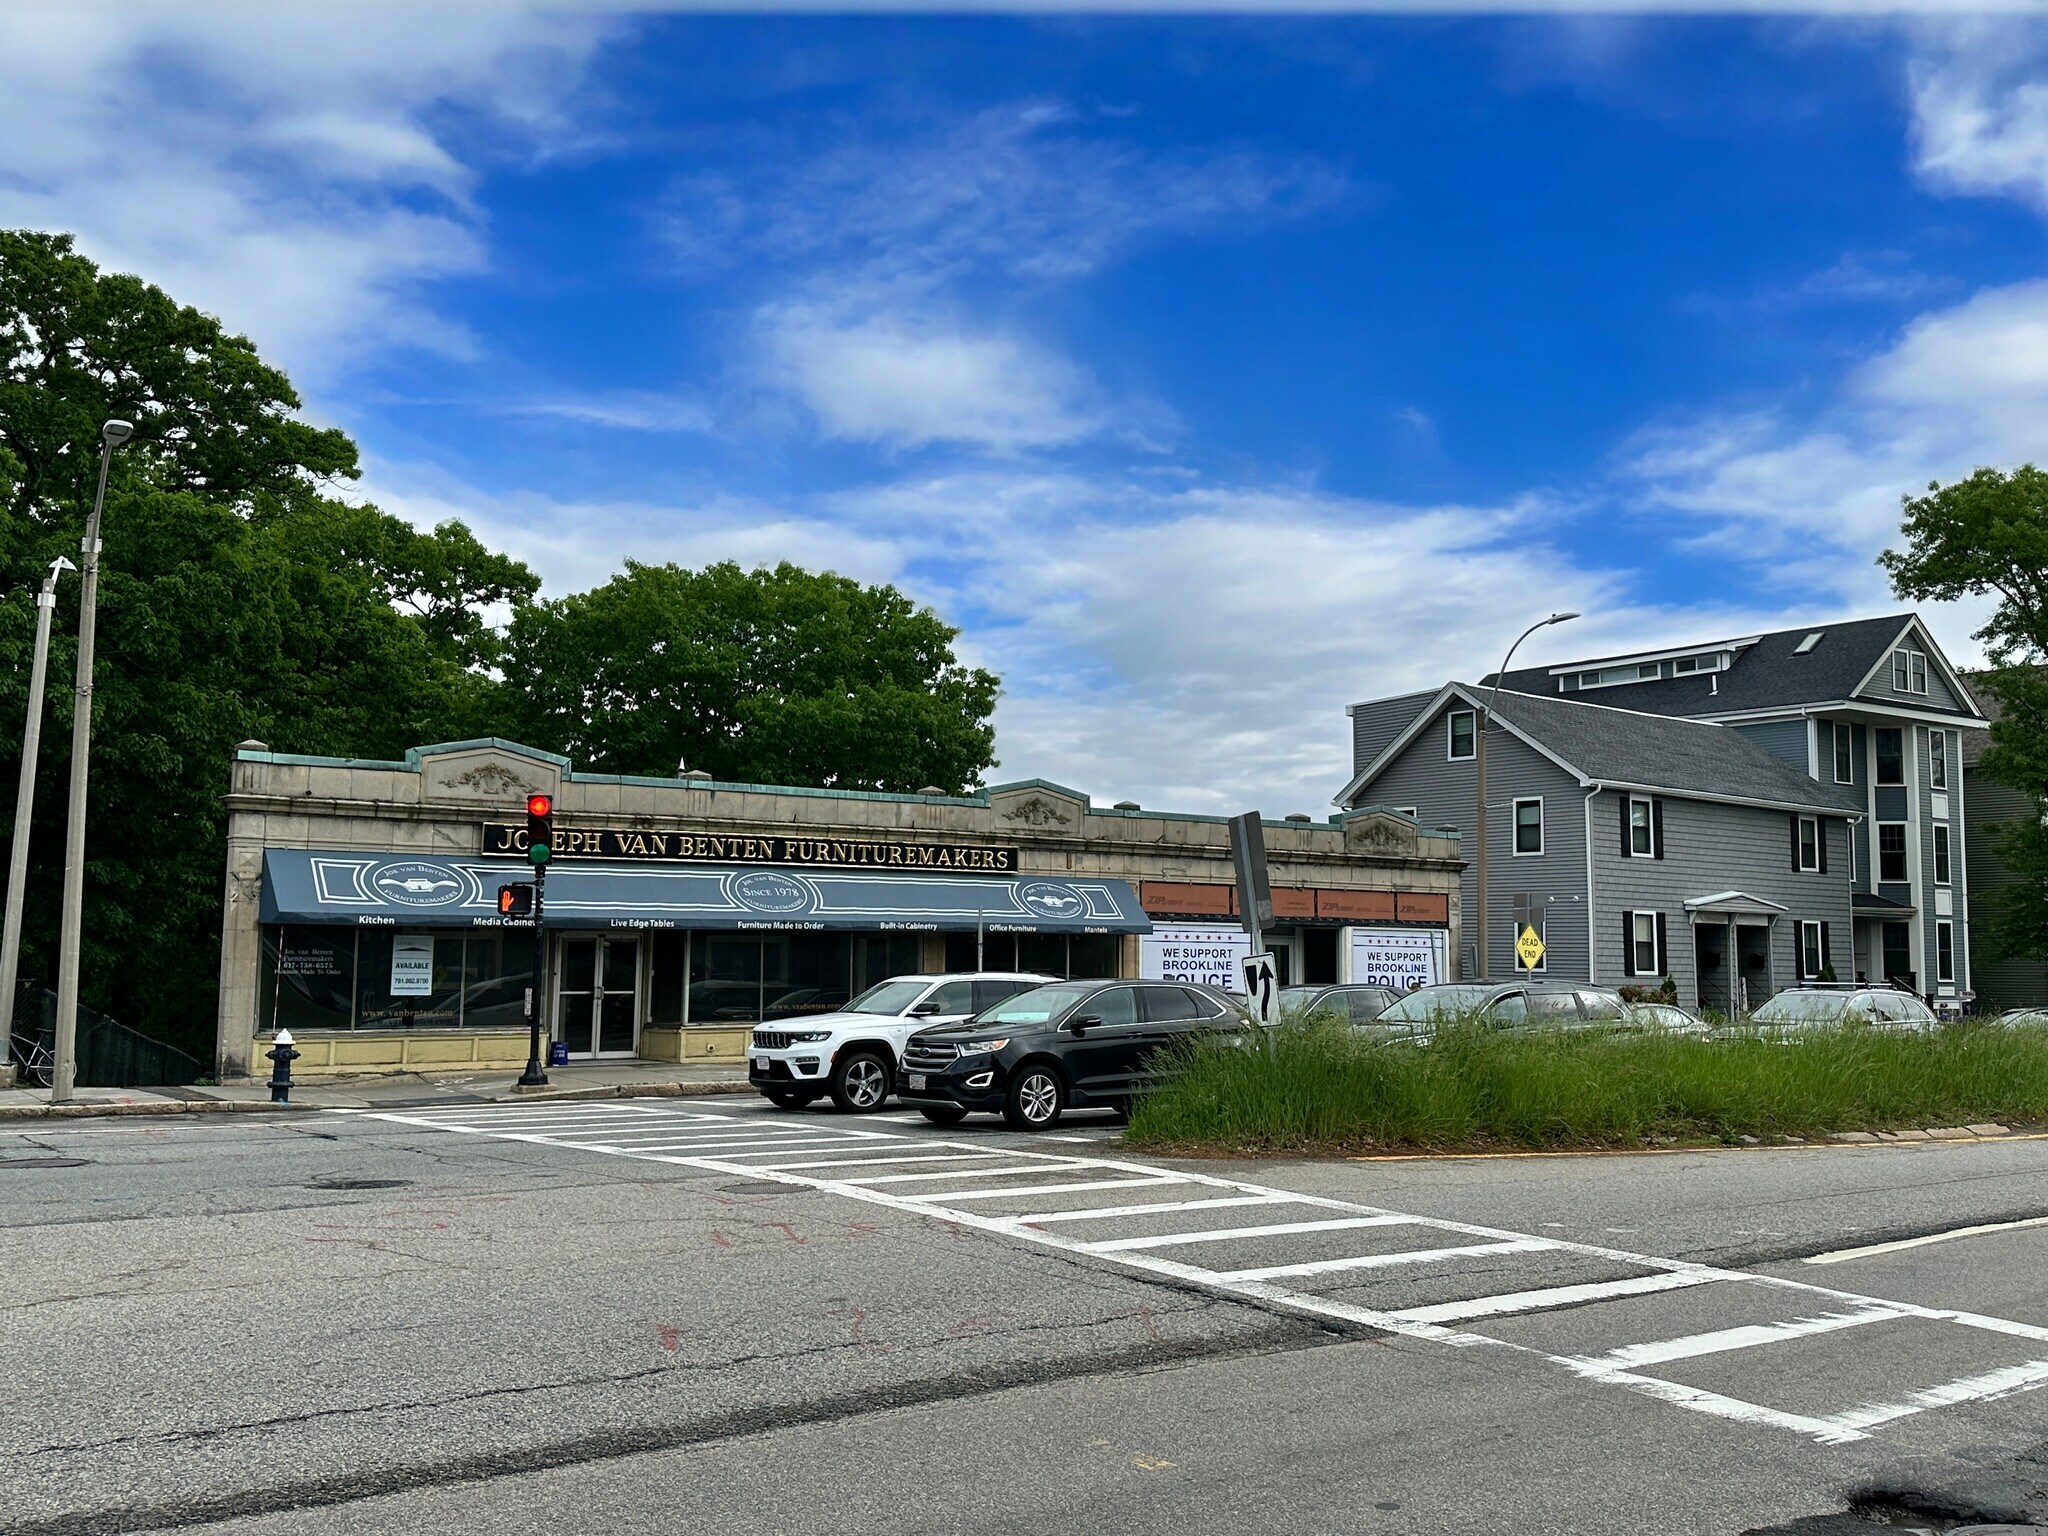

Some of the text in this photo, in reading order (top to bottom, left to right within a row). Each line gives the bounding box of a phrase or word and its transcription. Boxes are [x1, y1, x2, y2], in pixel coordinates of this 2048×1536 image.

[498, 829, 1009, 868] JOEPH VAN BENTEN FURNITUREMAKERS
[774, 888, 800, 897] 1978
[358, 916, 395, 924] Kitchen
[473, 918, 501, 926] Media
[610, 919, 675, 929] Live Edge Tables
[737, 920, 824, 930] Furniture Made to Order
[880, 922, 938, 932] Built-in Cabinetry
[990, 924, 1036, 932] Office Furniture
[1084, 926, 1108, 934] Mantels
[1522, 938, 1538, 946] DEAD
[1162, 948, 1233, 958] WE SUPPORT
[1367, 952, 1428, 962] WE SUPPORT
[1524, 950, 1536, 958] END
[1162, 960, 1233, 970] BROOKLINE
[1367, 964, 1428, 973] BROOKLINE
[388, 1008, 453, 1017] vanbenten.com
